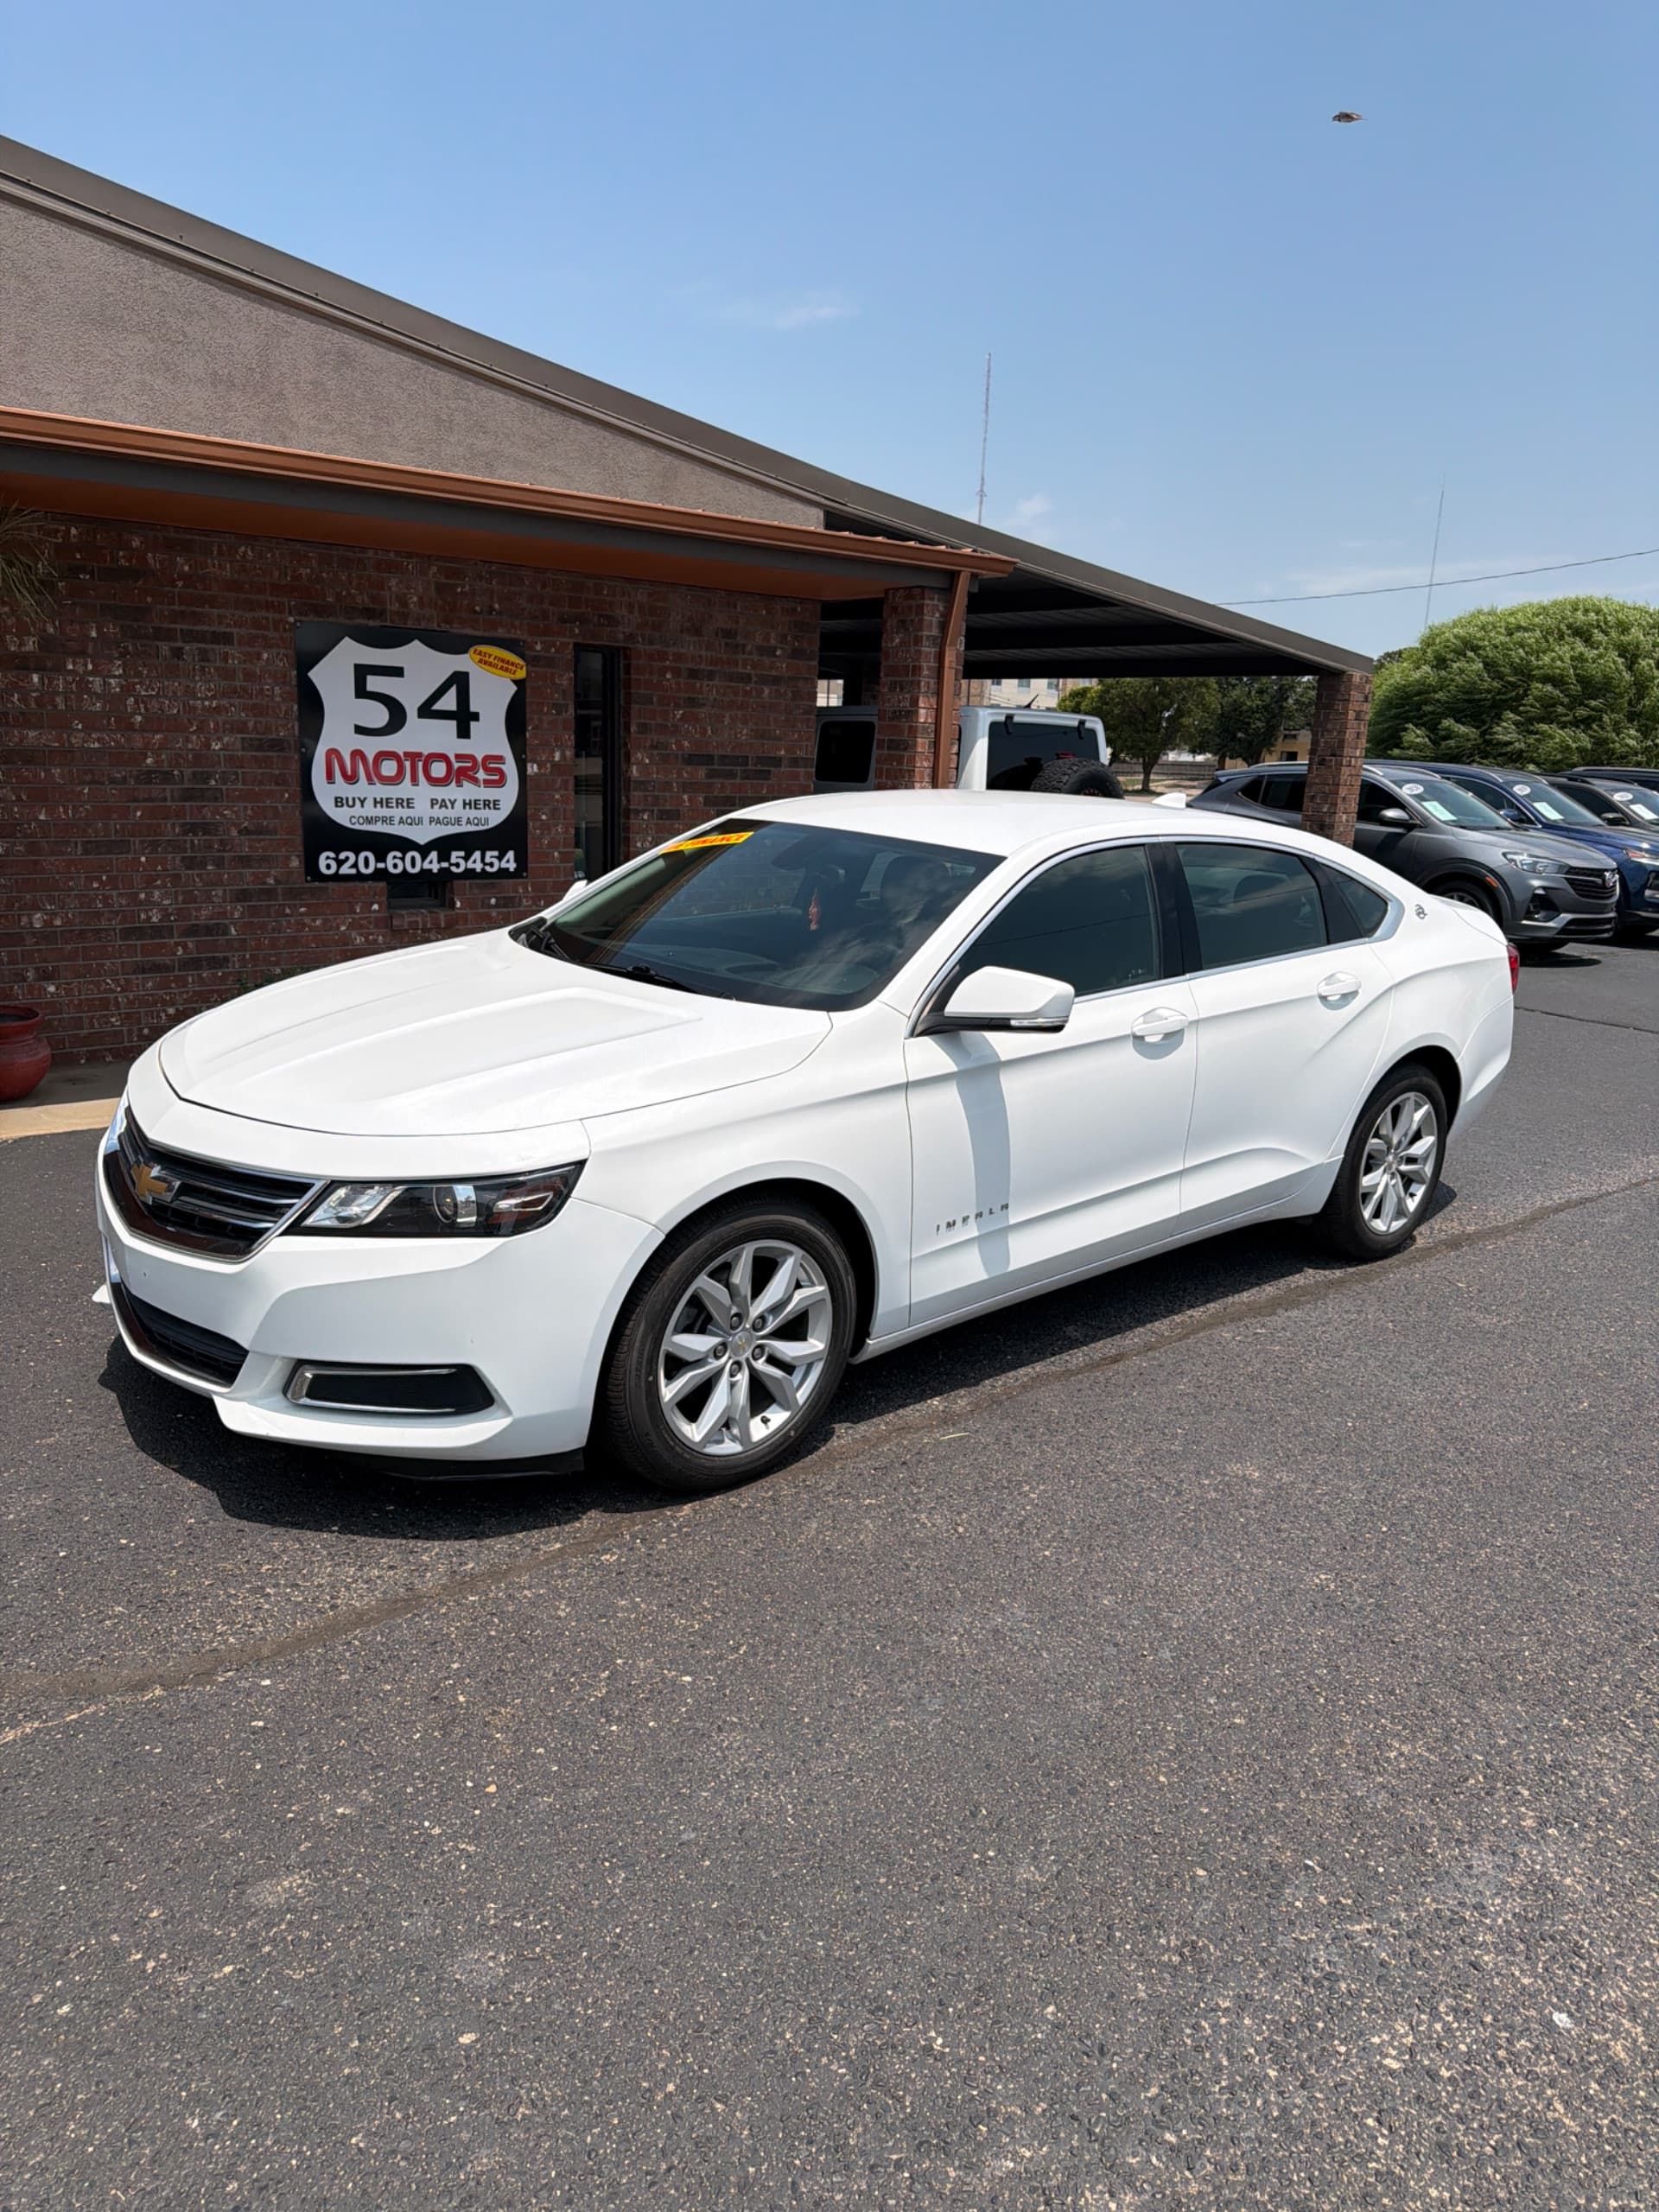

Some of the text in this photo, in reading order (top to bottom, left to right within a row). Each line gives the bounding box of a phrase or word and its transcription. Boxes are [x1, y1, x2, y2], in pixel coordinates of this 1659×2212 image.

[472, 648, 525, 671] EASY FINANCE
[477, 658, 518, 676] AVAILABLE
[353, 663, 480, 740] 54
[325, 747, 508, 788] MOTORS
[334, 796, 501, 810] BUY HERE PAY HERE
[349, 816, 490, 827] COMPRE AQUI PAGUE AQUI
[318, 849, 518, 874] 620-604-5454
[936, 1203, 1009, 1233] IMPALA
